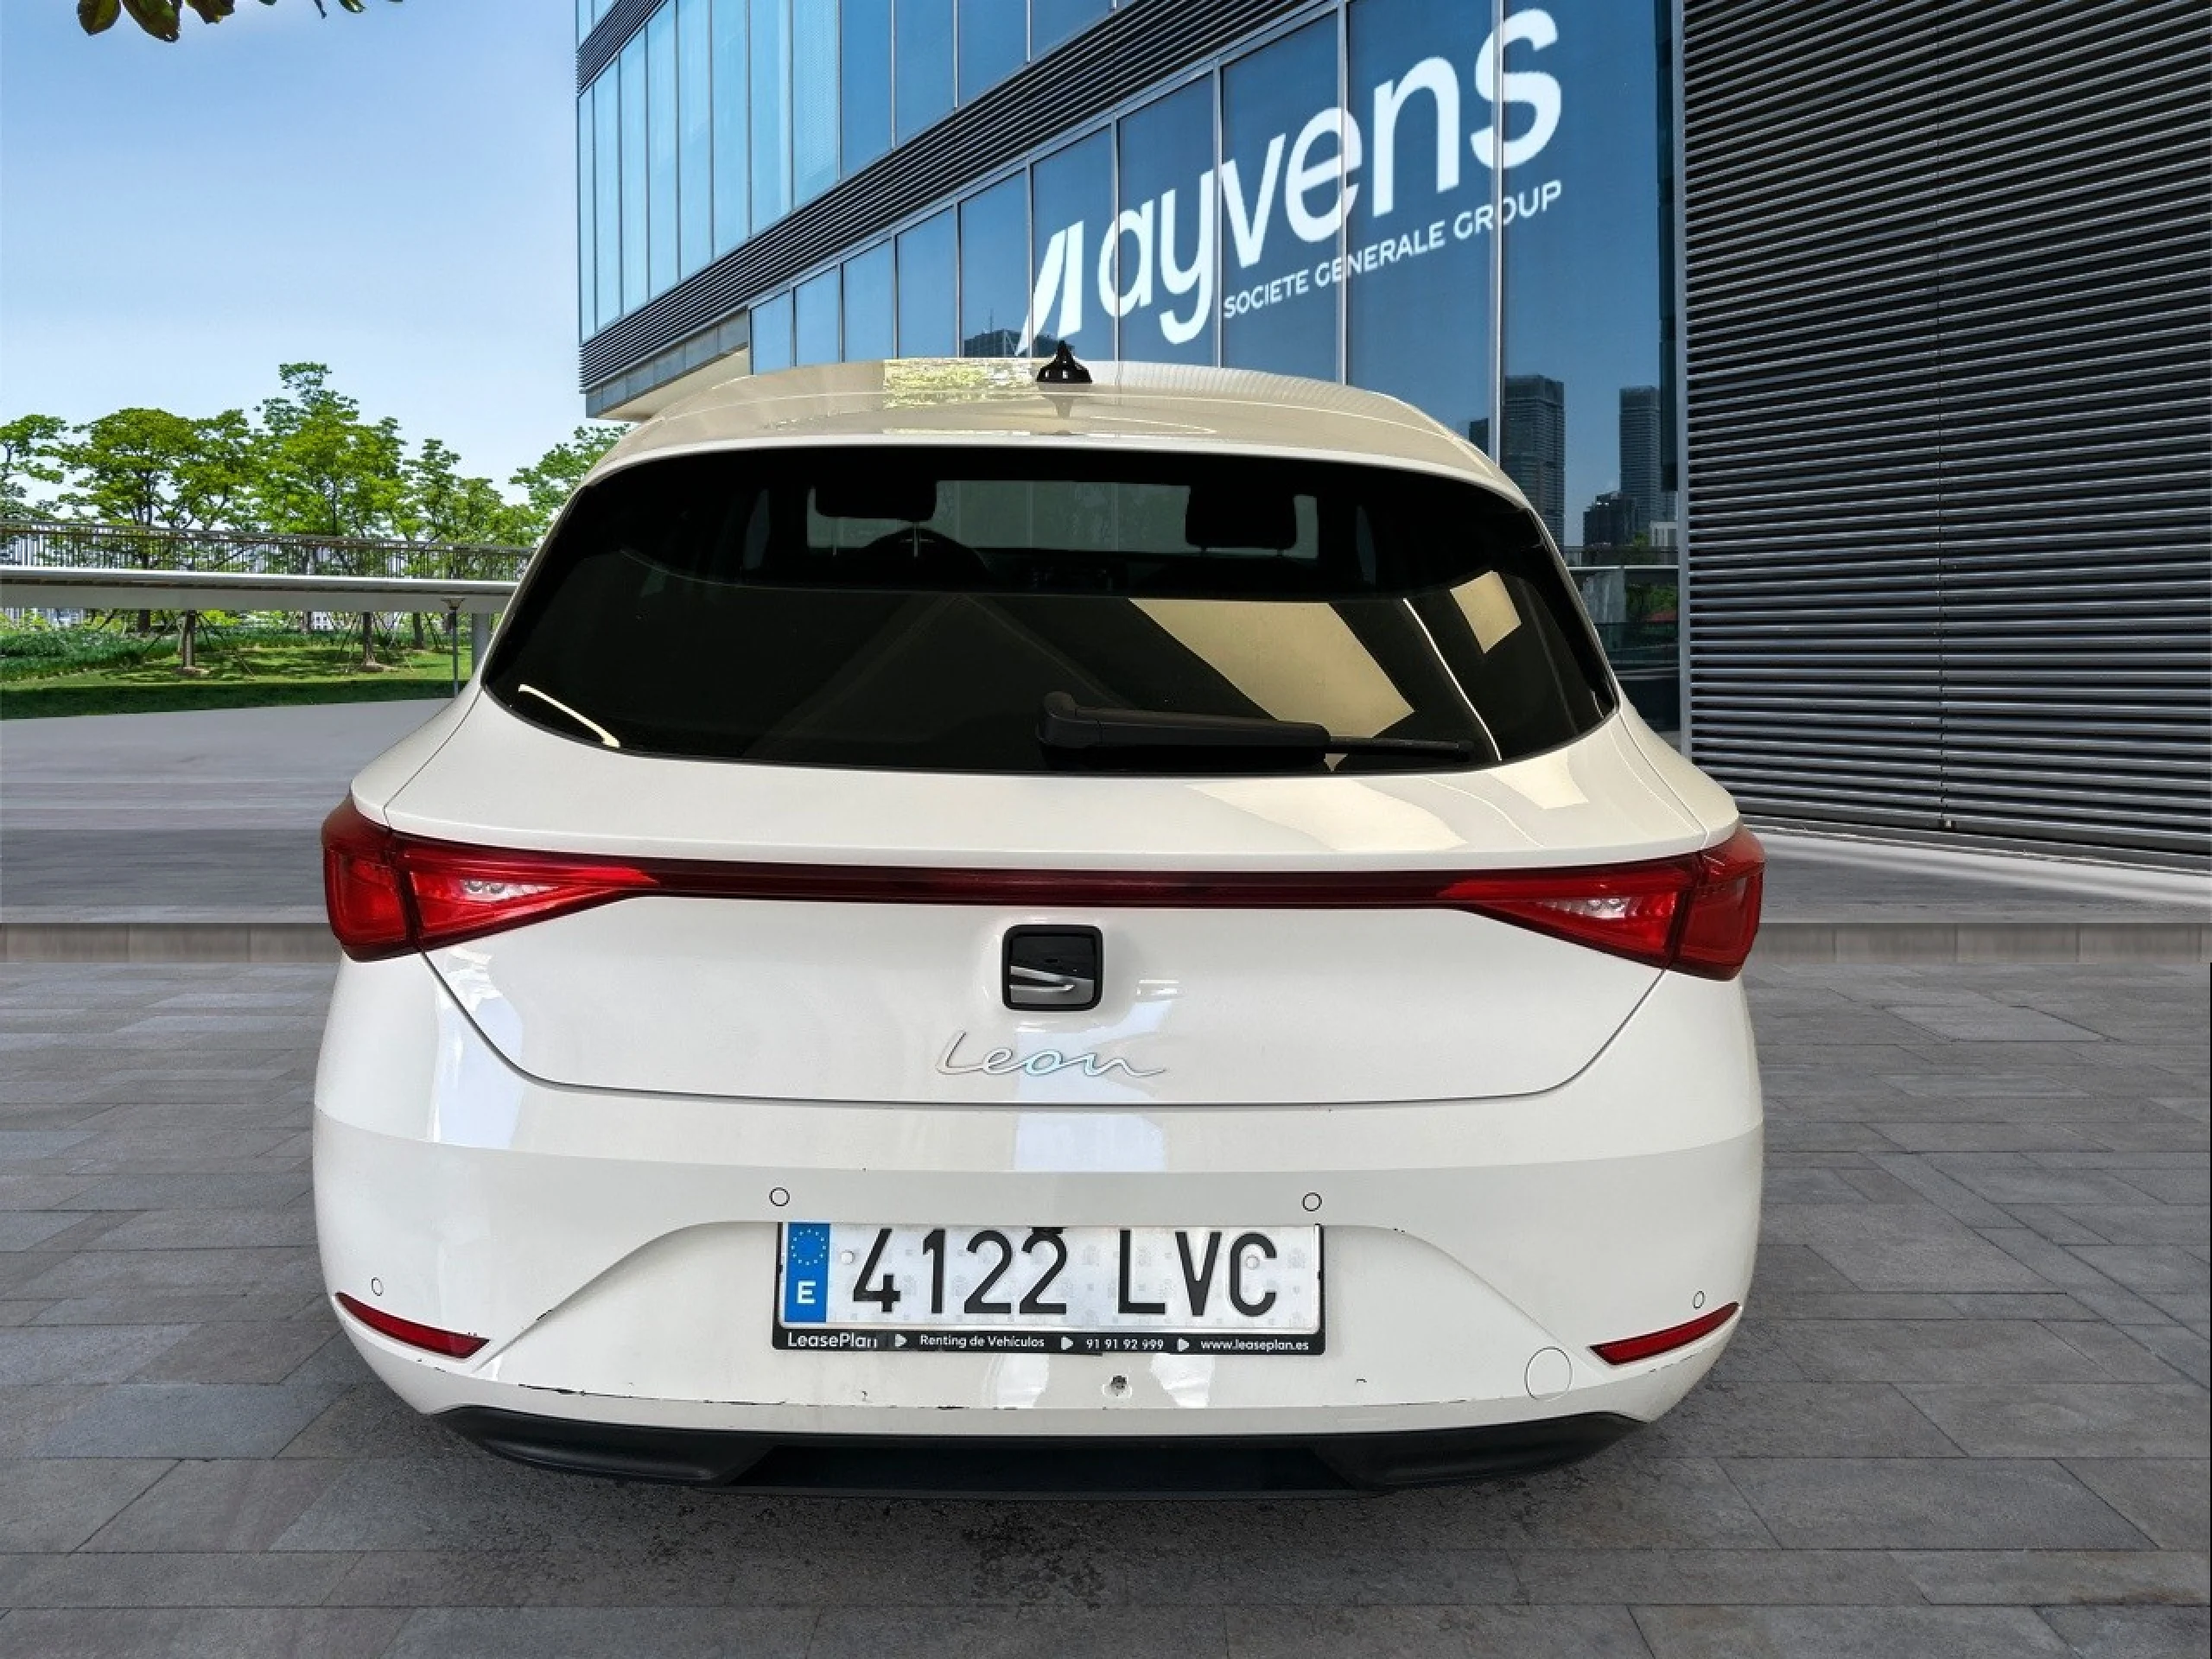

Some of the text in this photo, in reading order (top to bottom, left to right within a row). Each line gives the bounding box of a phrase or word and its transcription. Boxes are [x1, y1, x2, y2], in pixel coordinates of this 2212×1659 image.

[1097, 9, 1562, 345] ayvens
[1224, 179, 1562, 319] SOCIETE GENERALE GROUP
[935, 1030, 1168, 1077] Leon
[852, 1227, 1278, 1317] 4122 LVC
[796, 1281, 817, 1305] E
[787, 1332, 878, 1348] LeasePlan
[919, 1334, 967, 1349] Renting
[969, 1335, 985, 1347] de
[1086, 1338, 1165, 1351] 91 91 92 999
[1200, 1338, 1309, 1352] www.leaseplan.es
